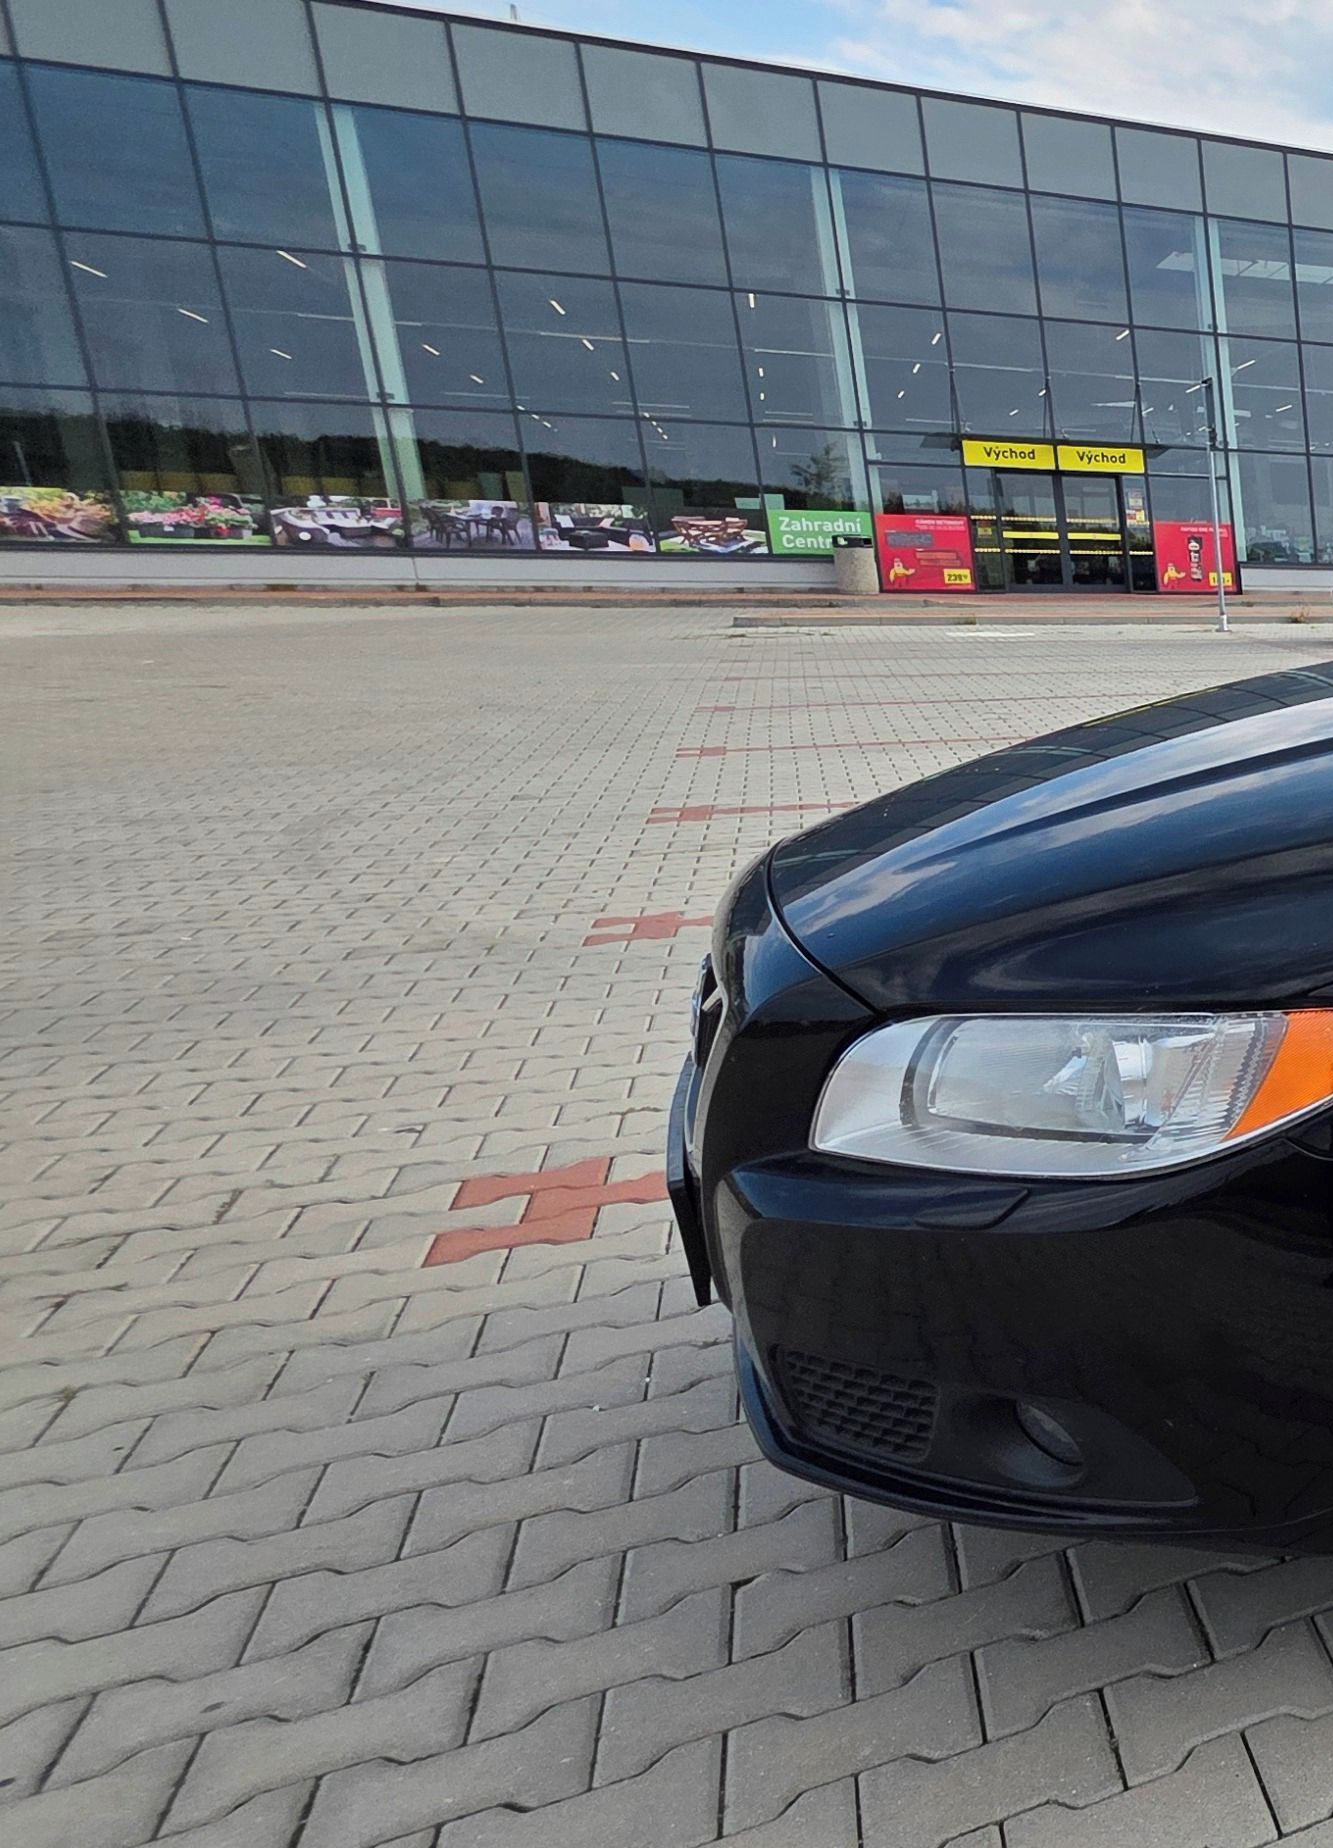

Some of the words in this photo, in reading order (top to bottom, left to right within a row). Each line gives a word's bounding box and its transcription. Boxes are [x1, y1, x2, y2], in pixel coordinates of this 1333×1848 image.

[983, 446, 1036, 461] Východ
[1076, 450, 1126, 464] Východ
[778, 516, 862, 533] Zahradní
[782, 534, 833, 549] Centr
